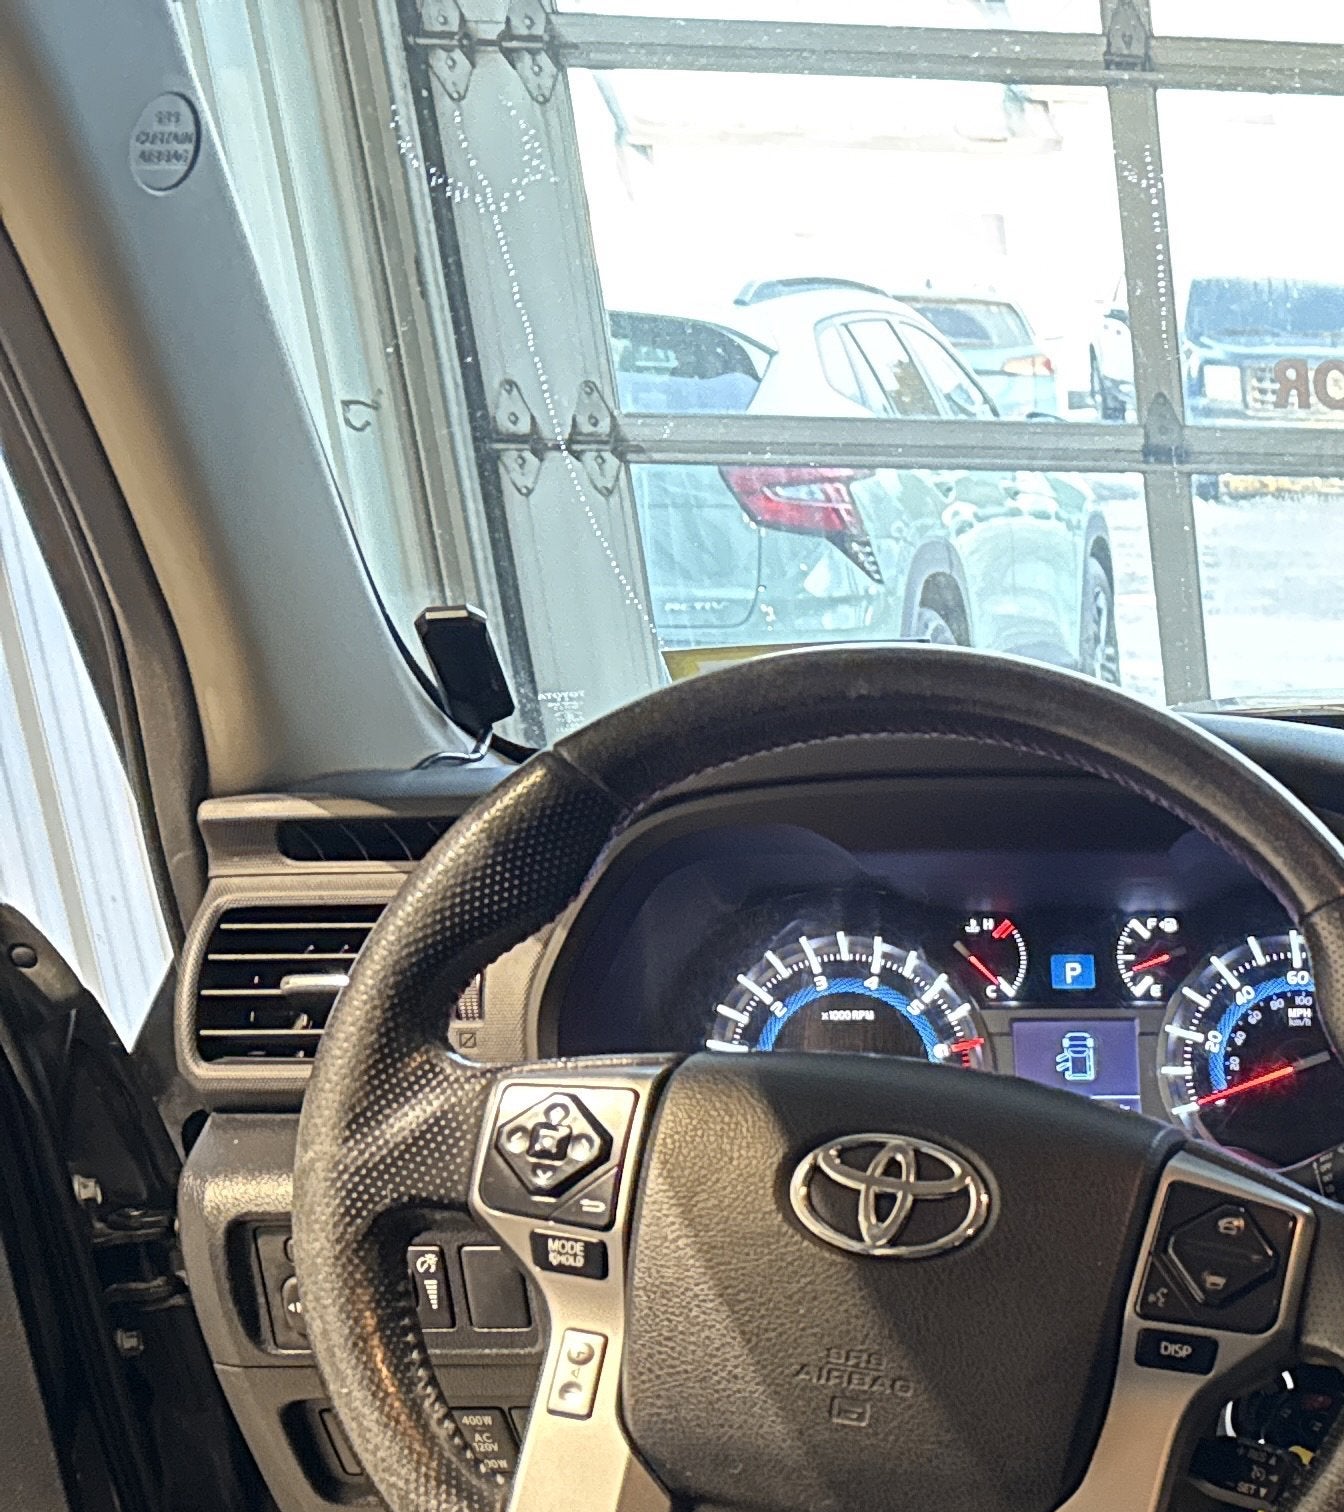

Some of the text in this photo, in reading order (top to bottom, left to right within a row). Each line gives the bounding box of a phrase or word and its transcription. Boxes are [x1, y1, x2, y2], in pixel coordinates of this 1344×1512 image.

[982, 918, 995, 931] H
[1146, 917, 1158, 929] F
[1065, 962, 1083, 984] P
[1286, 970, 1310, 985] 60
[813, 976, 829, 991] 3
[863, 975, 880, 991] 4
[985, 984, 998, 999] C
[1150, 984, 1163, 998] E
[1235, 985, 1256, 1006] 40
[906, 1000, 923, 1016] 5
[1294, 995, 1313, 1006] 100
[769, 1001, 788, 1018] 2
[852, 1009, 875, 1020] RPM
[1287, 1007, 1312, 1018] MPH
[1205, 1030, 1223, 1053] 20
[547, 1237, 585, 1257] MODE
[1159, 1341, 1193, 1358] DISP
[793, 1363, 915, 1398] AIRBAG
[461, 1415, 493, 1426] 400W
[474, 1432, 493, 1443] AC
[472, 1442, 499, 1452] 120V
